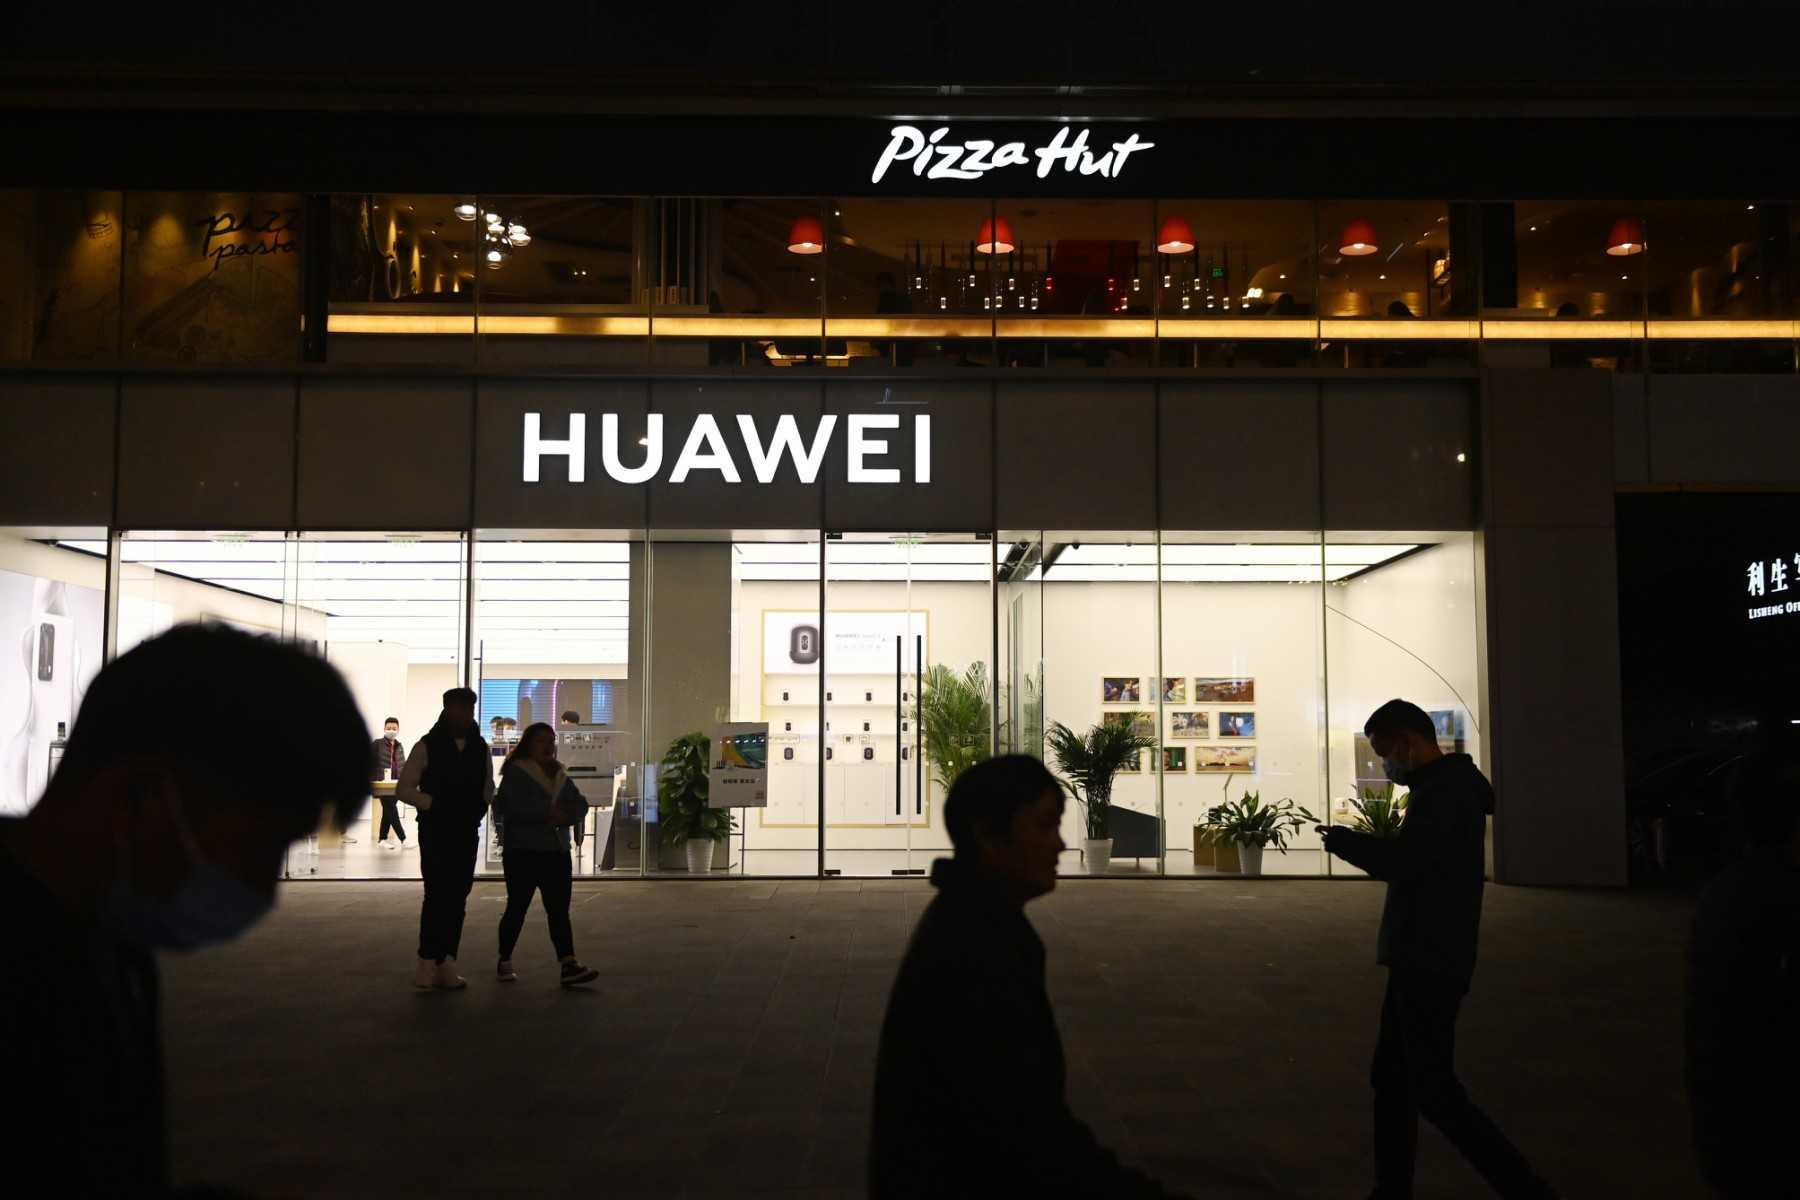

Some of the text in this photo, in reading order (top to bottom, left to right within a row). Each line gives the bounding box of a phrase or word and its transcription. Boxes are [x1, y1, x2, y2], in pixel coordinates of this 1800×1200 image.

[871, 125, 1156, 184] Pizza Hut
[522, 412, 931, 484] HUAWEI
